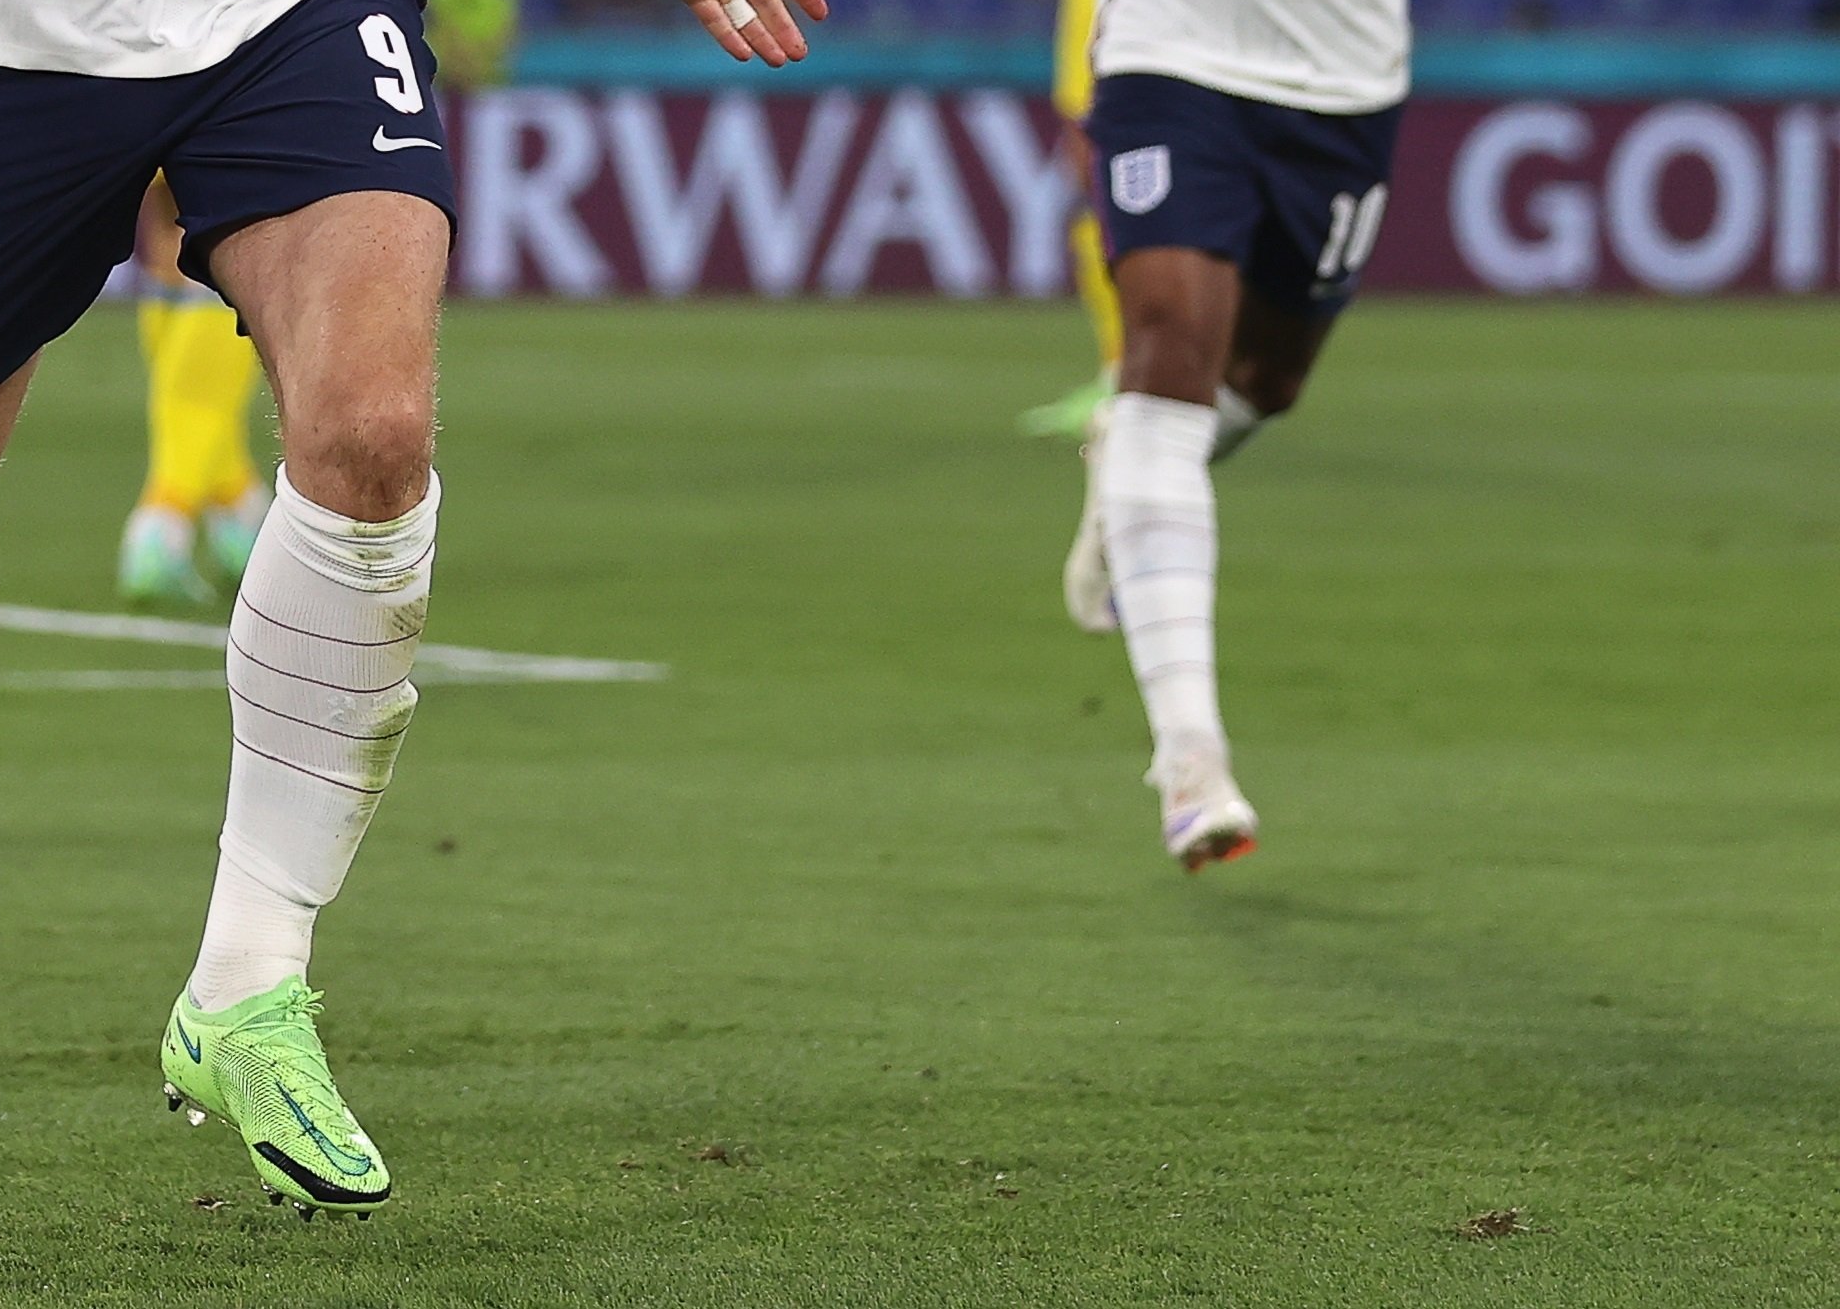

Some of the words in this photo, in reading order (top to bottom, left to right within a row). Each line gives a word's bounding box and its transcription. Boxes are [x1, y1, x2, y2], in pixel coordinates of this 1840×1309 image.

[357, 13, 425, 115] 9
[434, 84, 1096, 298] RWAY
[1448, 102, 1840, 294] GOI
